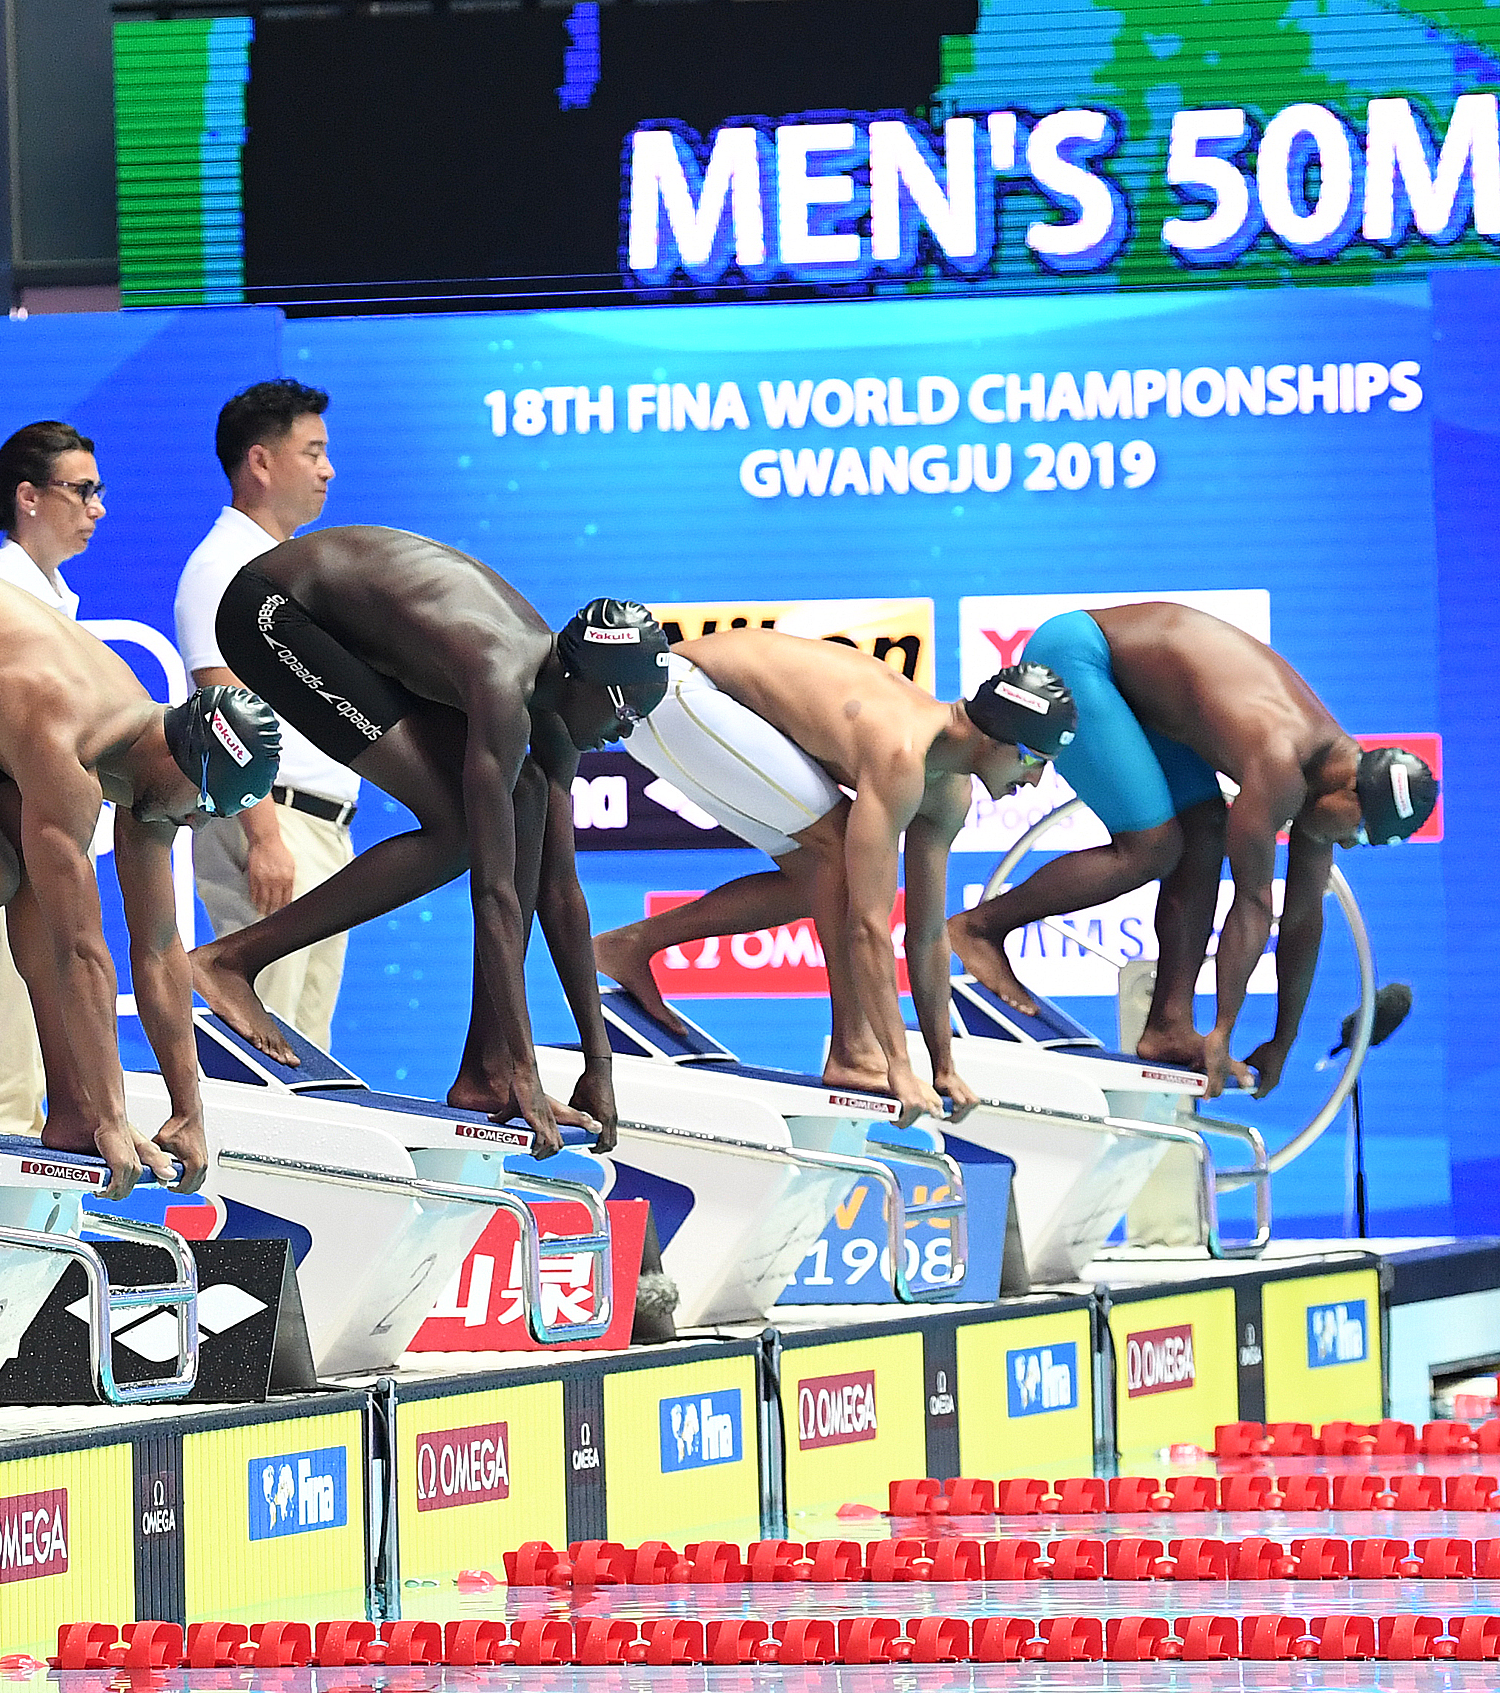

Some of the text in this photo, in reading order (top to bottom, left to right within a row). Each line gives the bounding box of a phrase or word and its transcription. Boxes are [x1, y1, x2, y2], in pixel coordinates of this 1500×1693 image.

[629, 92, 1500, 272] MEN'S 50M
[484, 360, 1424, 437] 18TH FINA WORLD CHAMPIONSHIPS
[739, 439, 1157, 499] GWANGJU 2019
[589, 630, 634, 640] Yakult
[277, 649, 324, 690] speedo
[212, 713, 245, 760] Yakult
[336, 700, 383, 741] speedo
[476, 1129, 520, 1145] OMEGA
[44, 1165, 91, 1182] OMEGA
[1143, 1336, 1196, 1387] OMEGA
[817, 1382, 878, 1438] OMEGA
[440, 1436, 510, 1497] OMEGA
[142, 1508, 176, 1536] OMEGA
